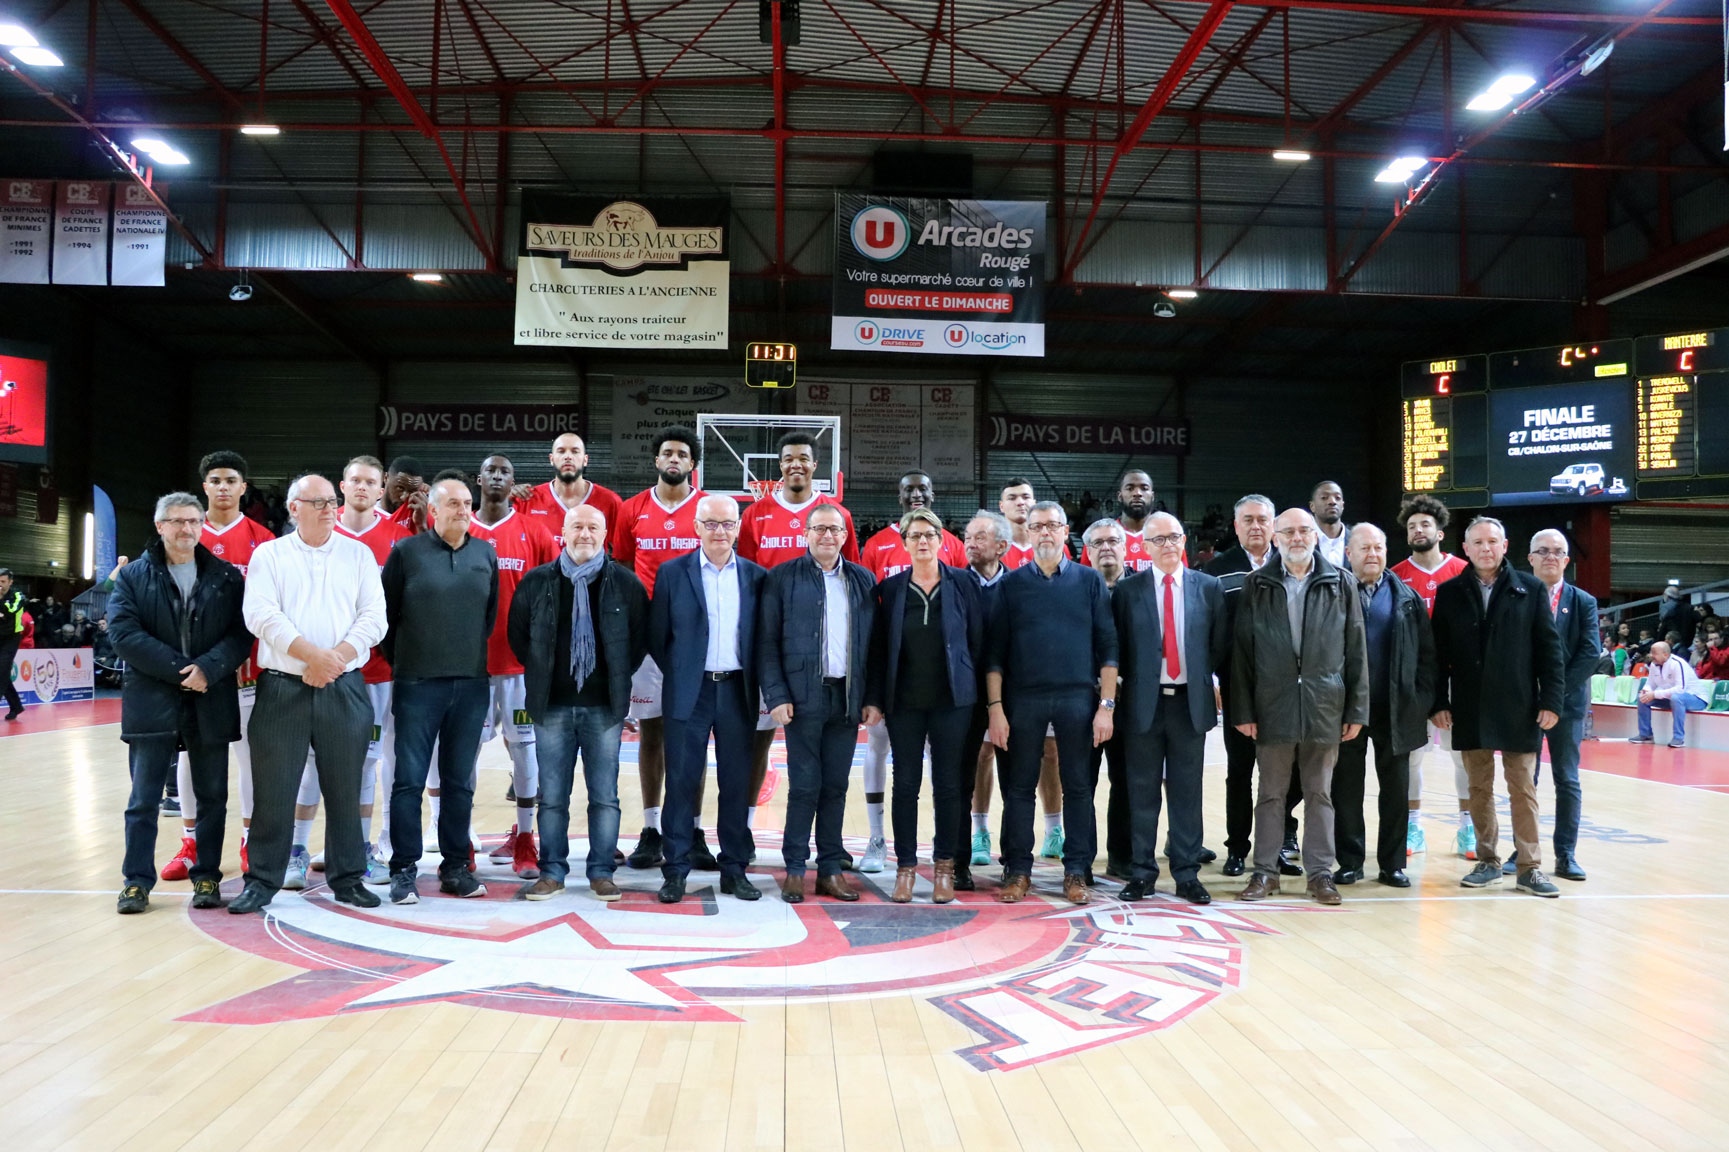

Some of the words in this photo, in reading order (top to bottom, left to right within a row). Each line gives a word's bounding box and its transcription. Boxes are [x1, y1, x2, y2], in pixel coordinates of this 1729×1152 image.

[609, 232, 640, 248] DES
[866, 220, 895, 248] U
[918, 220, 1034, 249] Arcades
[624, 250, 635, 259] de
[638, 250, 674, 261] l'Anjou
[980, 253, 1030, 272] Rougé
[847, 268, 877, 282] Votre
[881, 273, 951, 285] supermarché
[989, 276, 1003, 287] de
[1007, 277, 1026, 288] ville
[530, 283, 625, 296] CHARCUTERIES
[627, 287, 635, 296] A
[639, 286, 717, 297] L'ANCIENNE
[869, 294, 921, 307] OUVERT
[925, 296, 939, 308] LE
[943, 297, 1009, 310] DIMANCHE
[598, 315, 638, 326] rayons
[642, 314, 686, 324] traiteur
[520, 329, 531, 338] et
[534, 328, 562, 338] libre
[565, 330, 608, 340] service
[612, 330, 626, 341] de
[630, 332, 660, 341] votre
[860, 327, 873, 339] U
[882, 328, 926, 340] DRIVE
[950, 330, 963, 342] U
[971, 331, 1026, 344] location
[1664, 333, 1707, 350] NANTERRE
[1430, 360, 1456, 374] CHOLET
[808, 385, 829, 399] CB
[870, 387, 890, 402] CB
[932, 388, 952, 402] CB
[654, 407, 694, 418] Chaque
[1524, 404, 1594, 427] FINALE
[401, 413, 451, 432] PAYS
[459, 413, 485, 432] DE
[492, 413, 517, 432] LA
[524, 412, 579, 432] LOIRE
[637, 420, 658, 429] plus
[1010, 424, 1059, 443] PAYS
[1067, 426, 1092, 443] DE
[1100, 426, 1124, 444] LA
[1131, 427, 1187, 445] LOIRE
[1509, 431, 1527, 443] 27
[1531, 425, 1611, 442] DÉCEMBRE
[760, 536, 793, 548] CHOLET
[497, 556, 525, 571] ASKET
